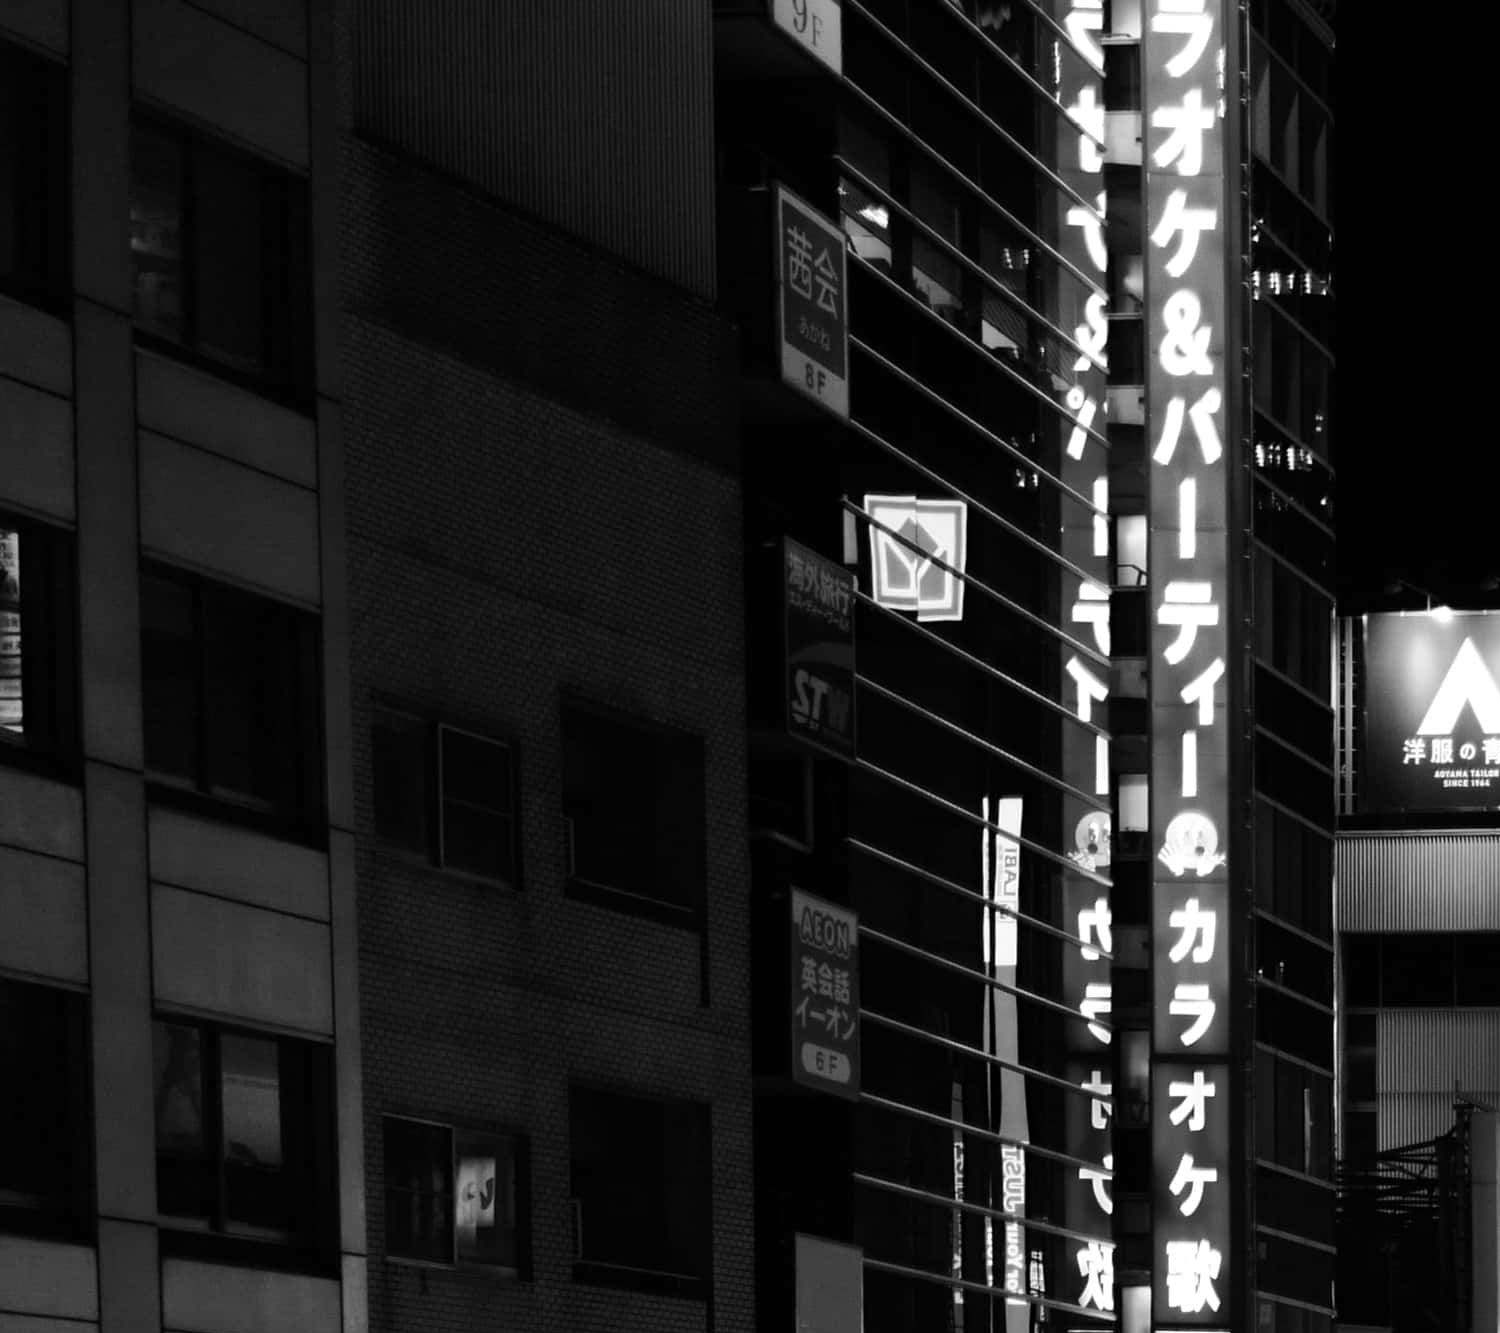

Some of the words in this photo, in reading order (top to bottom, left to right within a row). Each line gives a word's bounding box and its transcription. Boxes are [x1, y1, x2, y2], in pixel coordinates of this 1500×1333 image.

[806, 364, 826, 394] 8F
[1434, 769, 1467, 779] AOYAMA
[1468, 769, 1500, 778] TAILOR
[1442, 778, 1468, 788] SINCE
[801, 906, 849, 953] AEON
[801, 955, 850, 1003] 英会話
[815, 1050, 838, 1077] 6F
